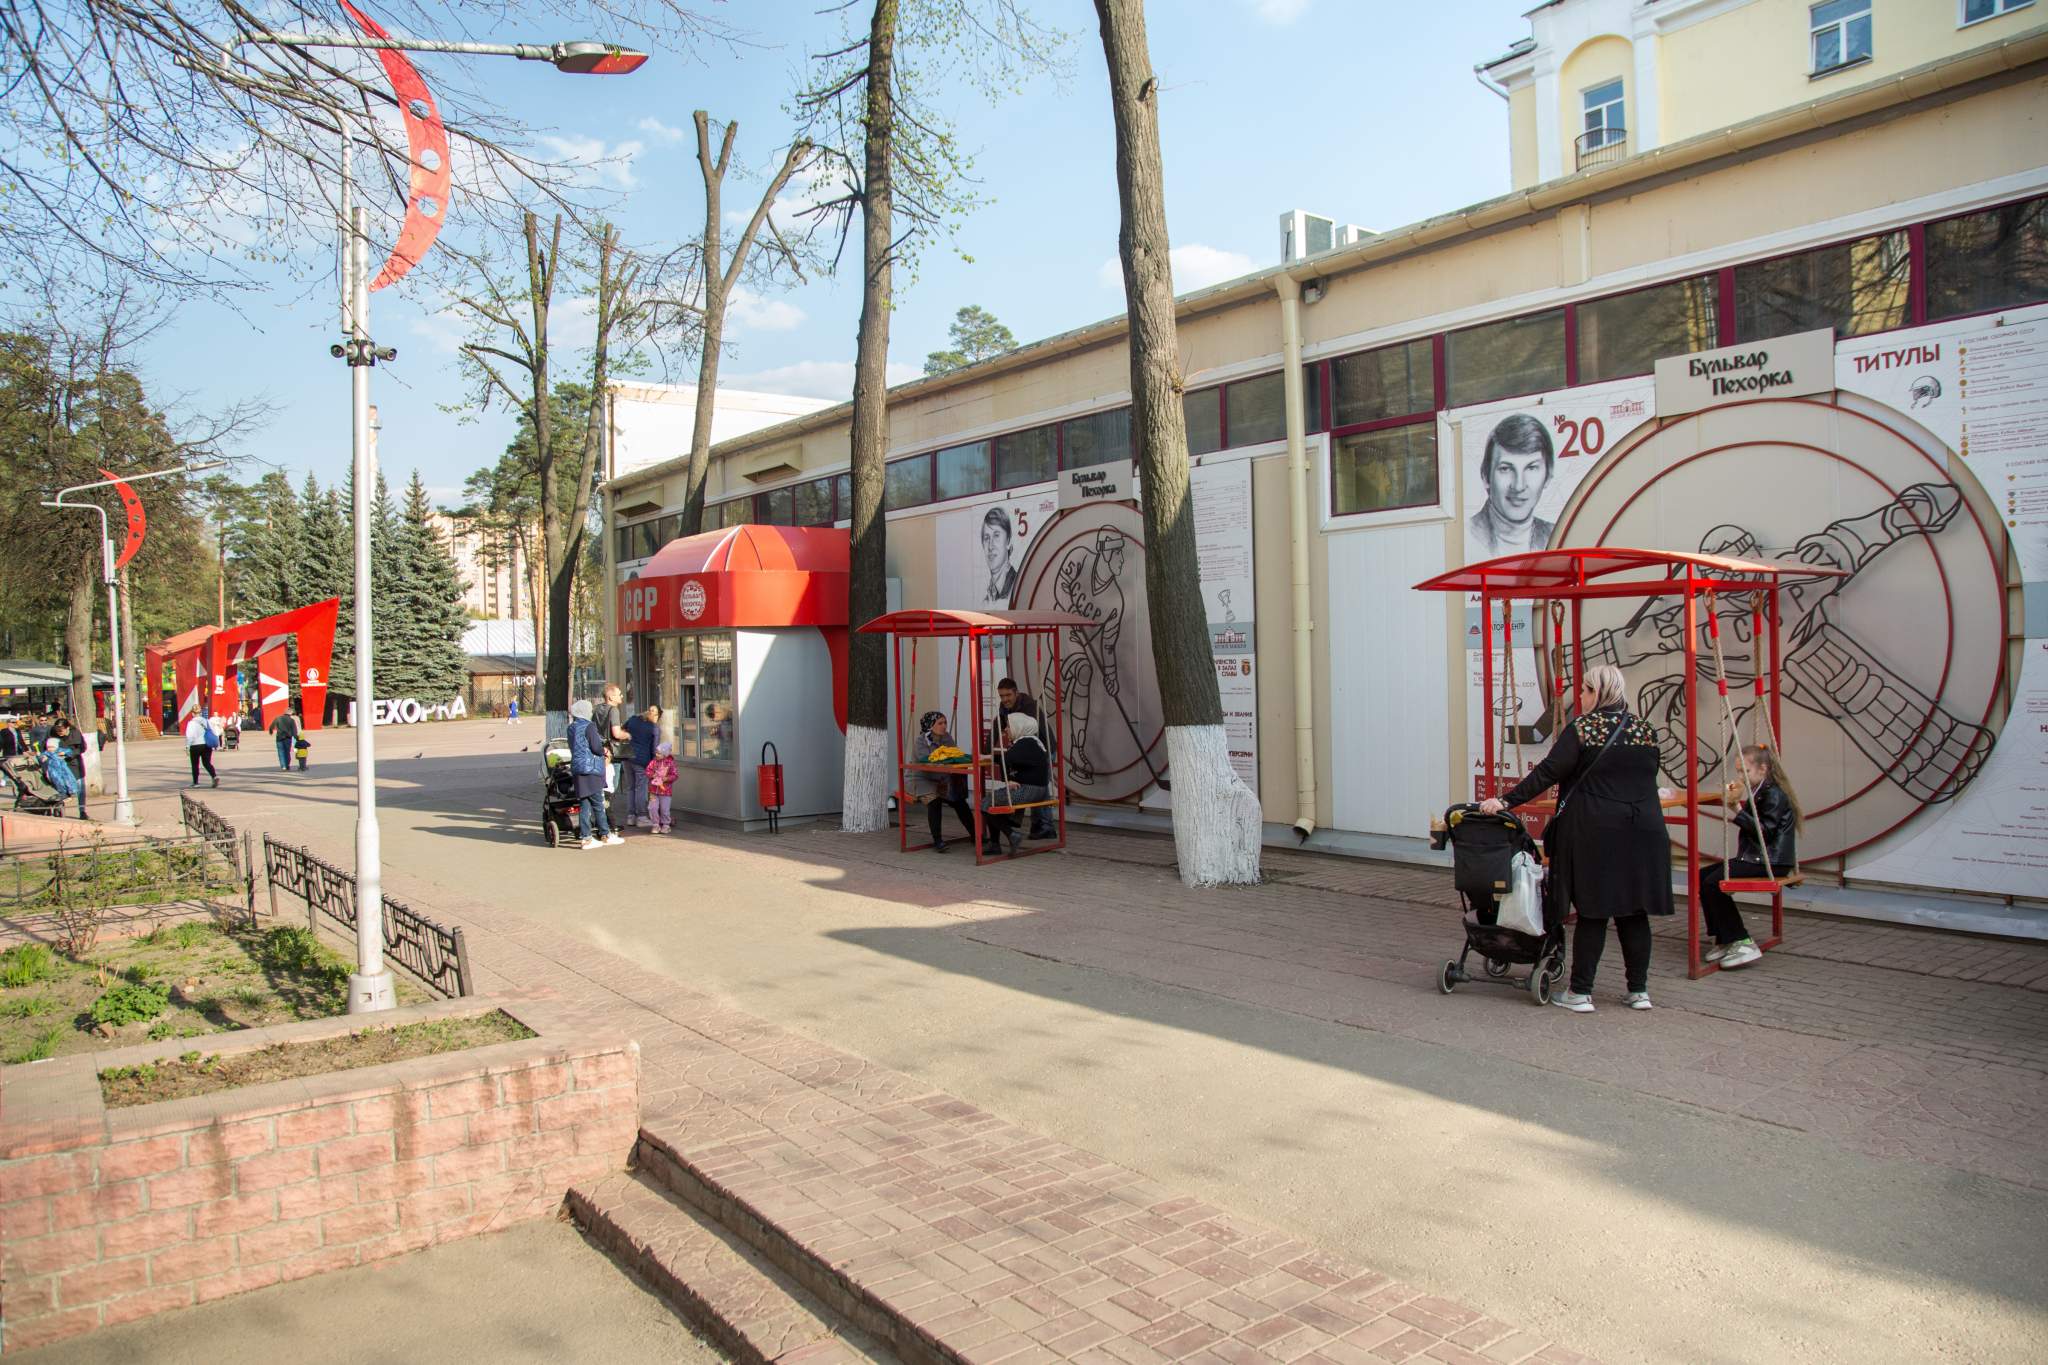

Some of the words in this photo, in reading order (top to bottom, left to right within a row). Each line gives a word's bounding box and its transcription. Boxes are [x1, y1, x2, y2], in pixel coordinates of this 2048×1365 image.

[1689, 351, 1768, 379] Бульвар
[1853, 343, 1941, 374] ТИТУЛЫ
[1712, 370, 1793, 397] Пехорка
[1557, 416, 1605, 459] 20
[1017, 511, 1028, 537] 5
[624, 586, 658, 622] ССР
